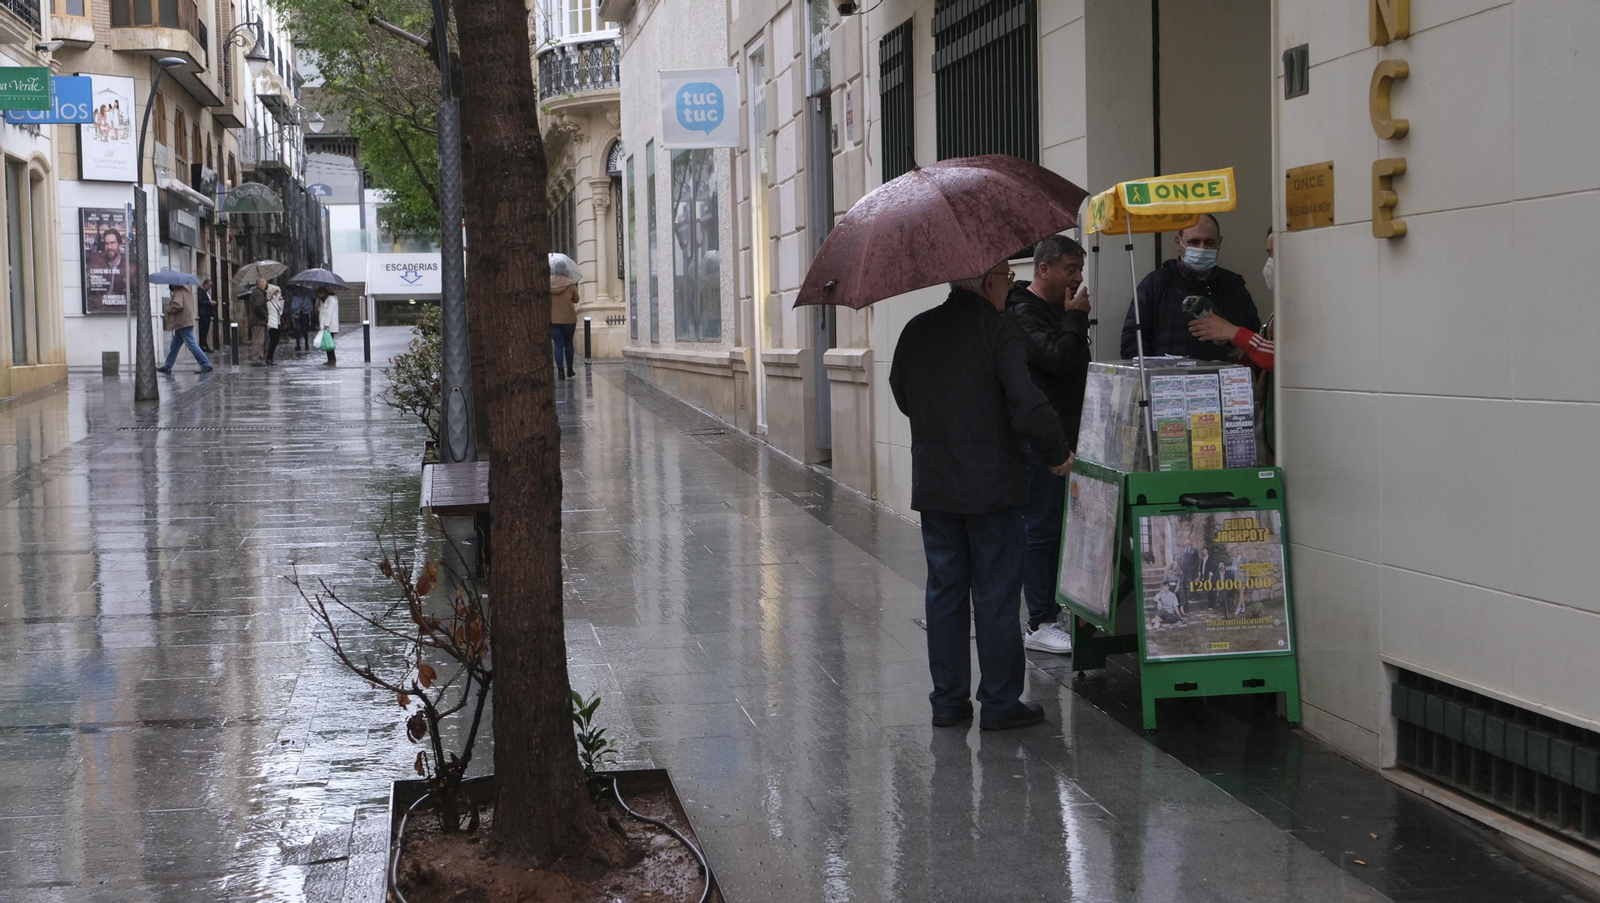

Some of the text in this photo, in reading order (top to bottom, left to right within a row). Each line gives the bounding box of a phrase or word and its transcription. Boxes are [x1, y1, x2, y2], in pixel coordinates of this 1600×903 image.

[9, 77, 44, 92] Verde
[682, 90, 717, 106] tuc
[683, 107, 718, 122] tuc
[1154, 180, 1222, 199] ONCE
[1293, 174, 1326, 191] ONCE
[1224, 517, 1254, 531] EURO
[1214, 527, 1266, 543] JACKPOT
